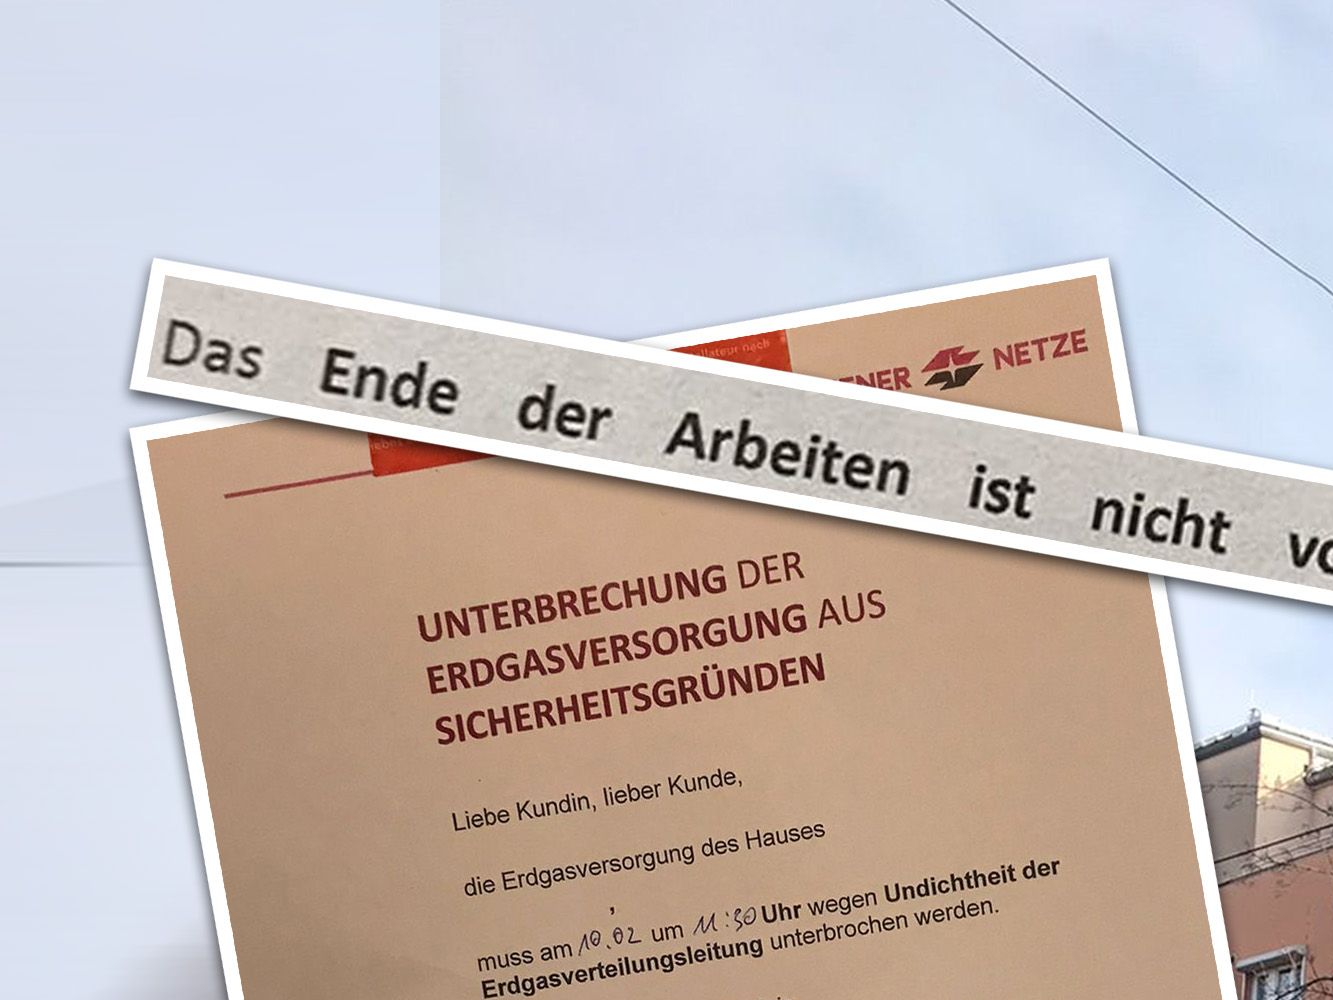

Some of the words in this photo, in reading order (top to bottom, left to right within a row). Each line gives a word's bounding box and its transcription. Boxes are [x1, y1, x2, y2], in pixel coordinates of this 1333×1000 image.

[993, 328, 1088, 370] NETZE
[417, 565, 727, 642] UNTERBRECHUNG
[737, 552, 805, 589] DER
[426, 604, 807, 694] ERDGASVERSORGUNG
[818, 590, 886, 629] AUS
[435, 653, 825, 745] SICHERHEITSGRÜNDEN
[452, 808, 510, 831] Liebe
[516, 793, 596, 821] Kundin,
[603, 783, 661, 806] lieber
[668, 768, 742, 796] Kunde,
[464, 876, 495, 896] die
[501, 845, 694, 891] Erdgasversorgung
[702, 837, 739, 857] des
[745, 824, 825, 850] Hauses
[477, 950, 534, 972] muss
[540, 943, 573, 961] am
[651, 924, 685, 942] um
[761, 903, 801, 923] Uhr
[807, 892, 877, 916] wegen
[884, 864, 1017, 903] Undichtheit
[1022, 860, 1060, 879] der
[481, 939, 763, 999] Erdgasverteilungsleitung
[770, 915, 908, 950] unterbrochen
[914, 900, 999, 926] werden.
